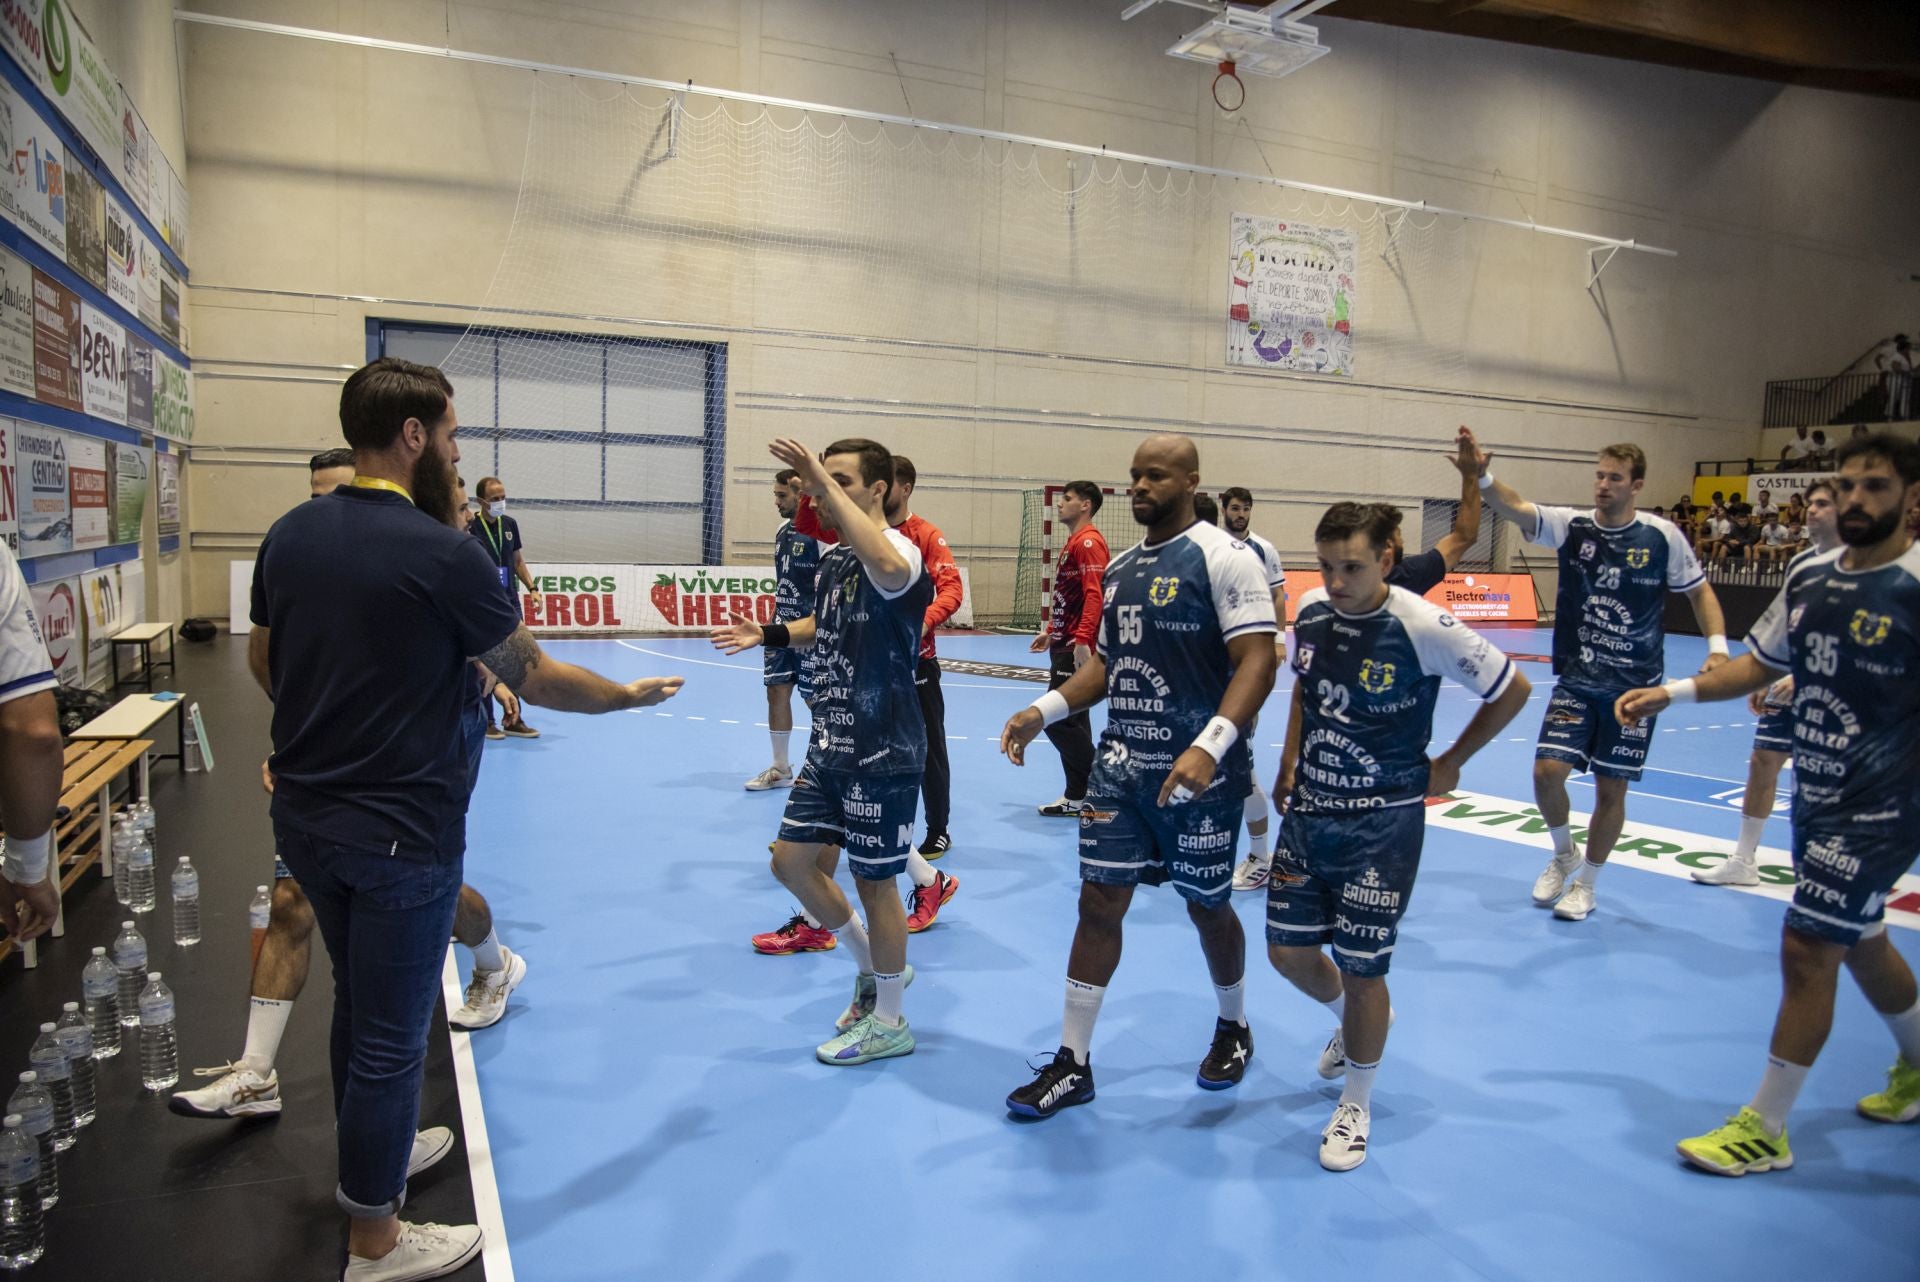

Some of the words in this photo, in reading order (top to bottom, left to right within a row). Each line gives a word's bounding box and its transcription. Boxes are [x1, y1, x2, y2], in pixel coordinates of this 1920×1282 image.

[1257, 280, 1267, 294] EL
[1269, 282, 1300, 300] DEPORTE
[83, 323, 127, 394] BERNA
[680, 570, 777, 594] VIVERO
[1594, 564, 1621, 591] 28
[1446, 590, 1511, 602] Electronava
[524, 594, 621, 627] EROL
[682, 594, 776, 627] HERO
[1117, 604, 1143, 646] 55
[1590, 633, 1634, 652] CASTRO
[1805, 631, 1840, 677] 35
[1119, 677, 1140, 692] DEL
[1317, 679, 1351, 724] 22
[1319, 750, 1344, 769] DEL
[1797, 755, 1846, 778] ASTRO
[1302, 762, 1375, 789] MORRAZO
[1039, 1071, 1083, 1110] MUNIC
